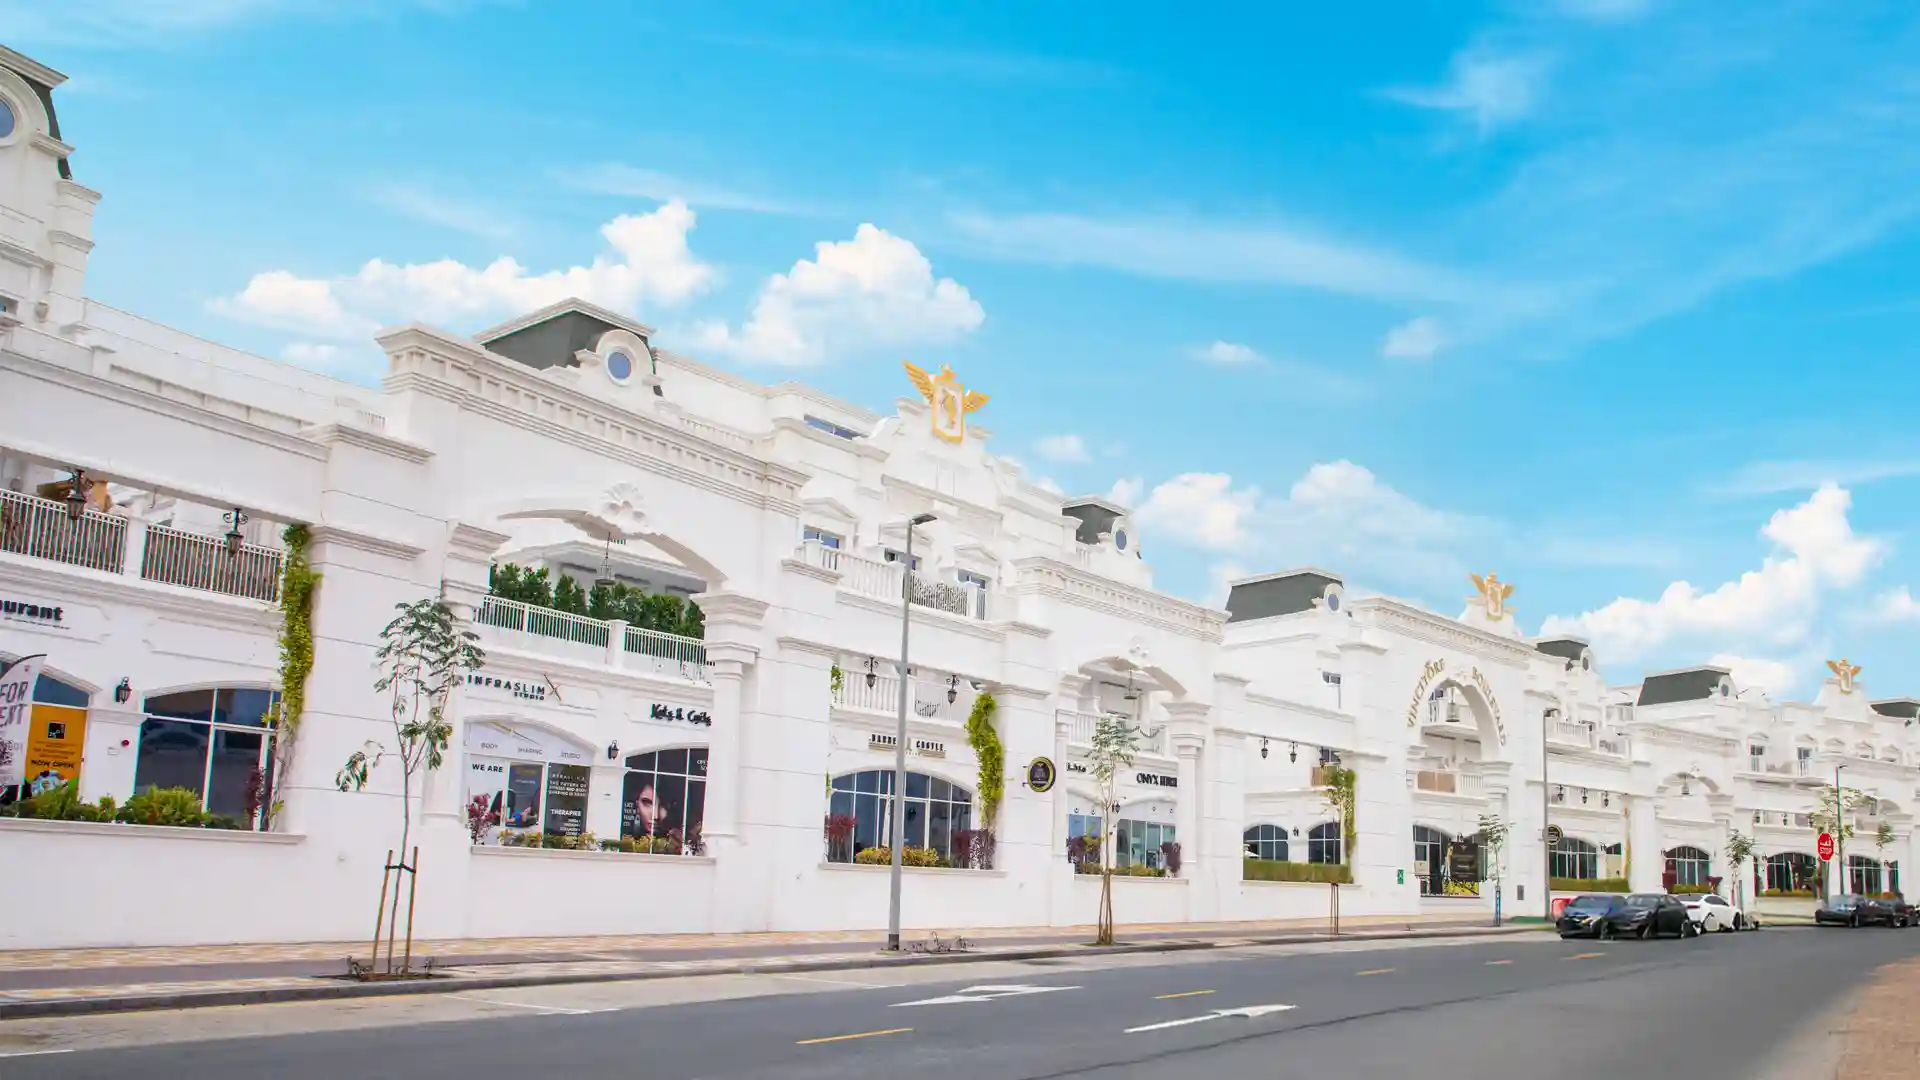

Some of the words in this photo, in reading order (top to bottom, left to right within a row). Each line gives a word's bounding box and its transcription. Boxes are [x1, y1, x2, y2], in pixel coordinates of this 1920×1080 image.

[0, 600, 63, 621] urant
[467, 674, 545, 695] INFRASLIM
[514, 692, 545, 701] STUDIO
[675, 707, 684, 721] &
[871, 734, 897, 745] BARBE
[916, 740, 944, 752] CASTLE
[472, 763, 485, 771] WE
[487, 765, 503, 773] ARE
[1136, 772, 1159, 785] ONYX
